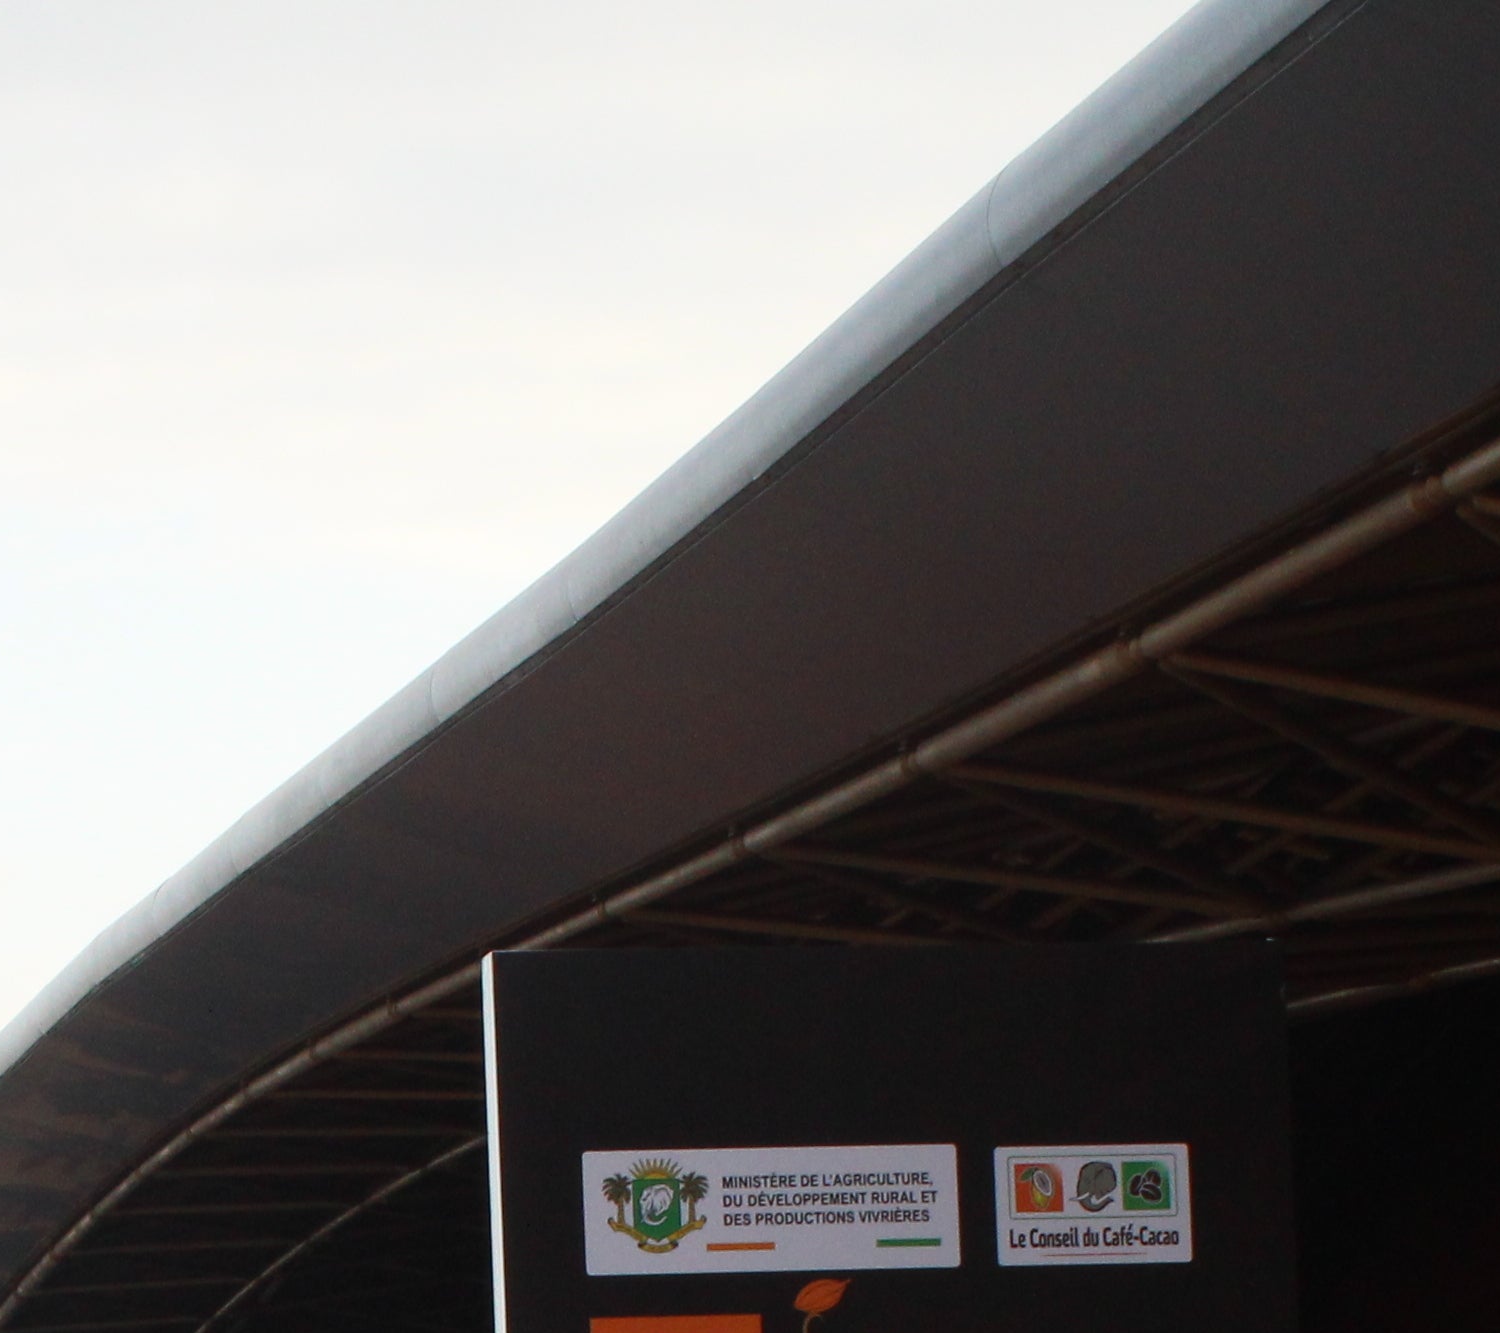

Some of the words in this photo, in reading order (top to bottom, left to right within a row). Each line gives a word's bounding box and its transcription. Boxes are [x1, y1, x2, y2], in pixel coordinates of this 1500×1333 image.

[722, 1172, 797, 1189] MINISTÈRE
[800, 1174, 818, 1187] DE
[723, 1194, 743, 1208] DU
[747, 1190, 866, 1207] DÉVELOPPEMENT
[871, 1191, 917, 1204] RURAL
[921, 1190, 938, 1203] ET
[723, 1213, 750, 1226] DES
[755, 1210, 855, 1226] PRODUCTIONS
[858, 1206, 930, 1223] VIVRIÈRES
[1009, 1229, 1026, 1248] Le
[1030, 1227, 1080, 1248] Conseil
[1083, 1227, 1099, 1247] du
[1103, 1224, 1179, 1246] Café-Cacao
